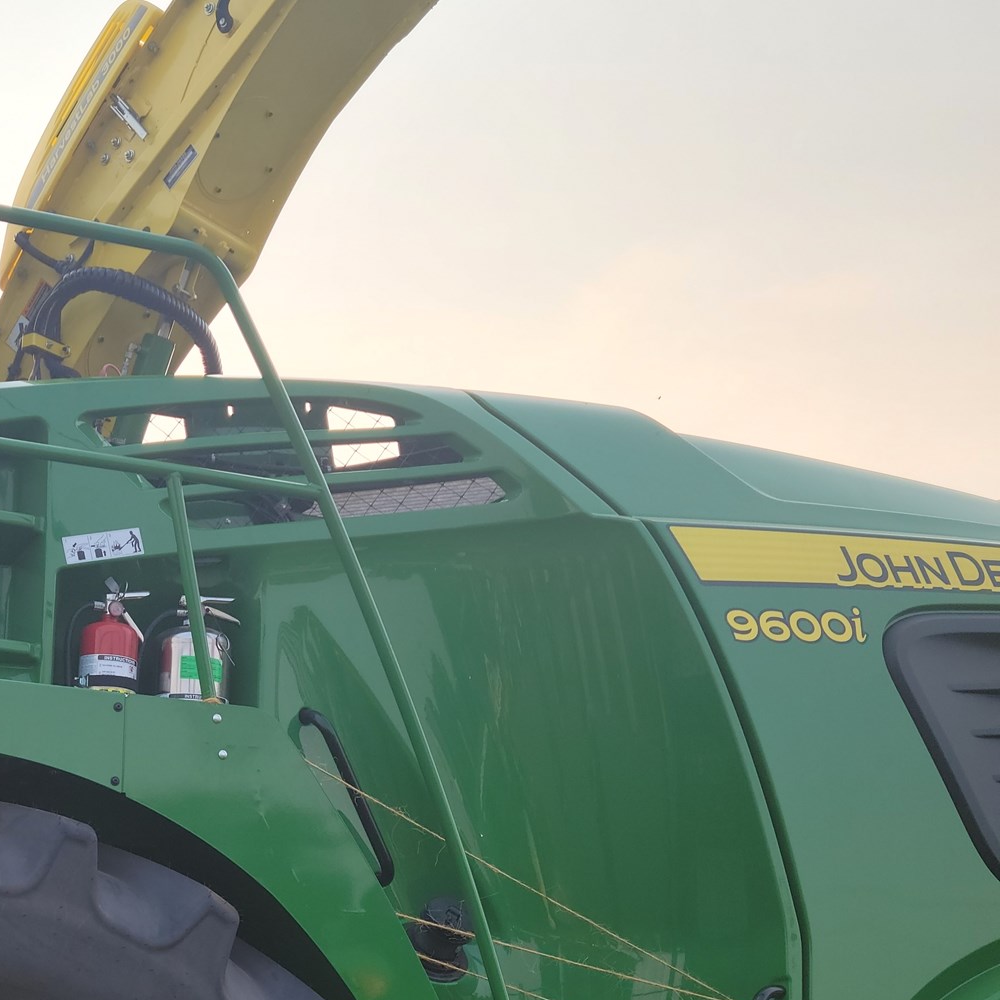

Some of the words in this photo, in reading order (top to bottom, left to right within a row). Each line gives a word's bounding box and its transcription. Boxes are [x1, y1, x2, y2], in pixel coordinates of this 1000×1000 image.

[41, 79, 100, 183] HarvestLab
[101, 27, 131, 77] 3000
[837, 545, 951, 585] JOHN
[725, 606, 868, 644] 9600i
